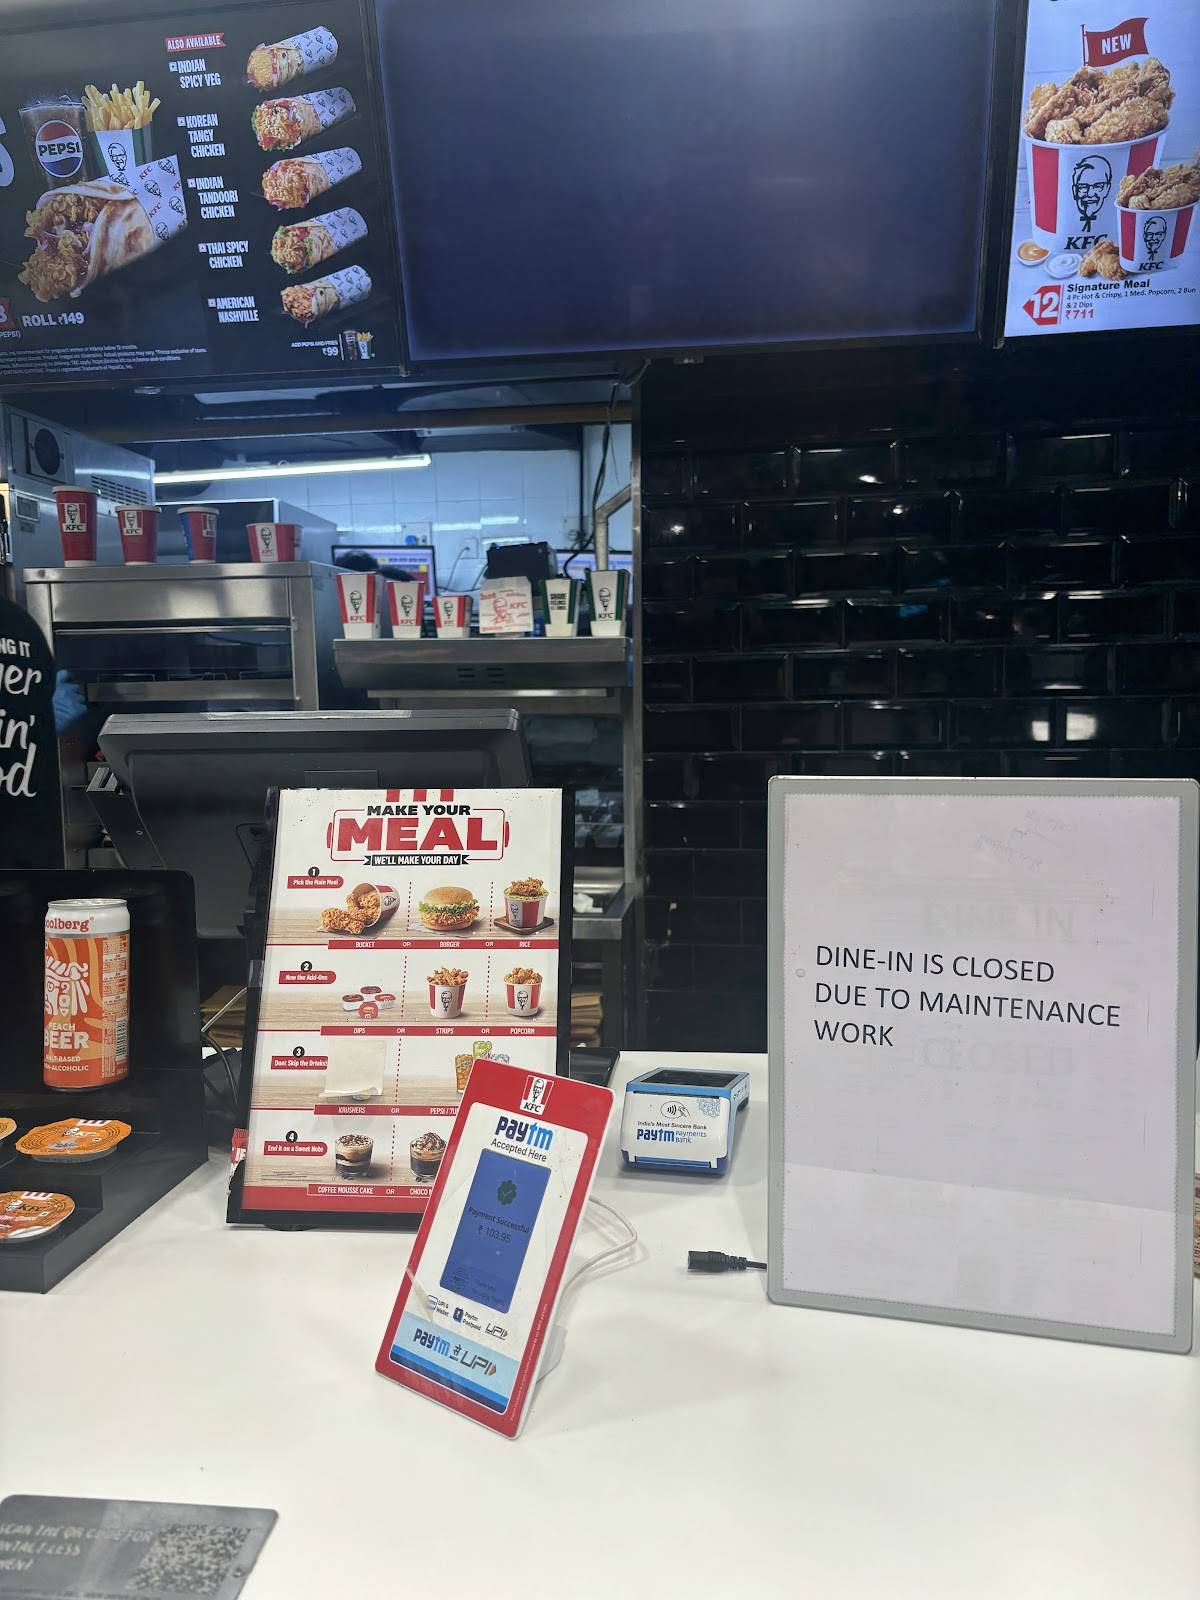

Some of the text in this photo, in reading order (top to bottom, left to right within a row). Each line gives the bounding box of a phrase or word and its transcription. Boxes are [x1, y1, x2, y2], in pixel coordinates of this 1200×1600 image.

[167, 35, 221, 50] ALSO AVAILABLE
[1102, 33, 1131, 55] NEW
[177, 58, 206, 73] INDIAN
[180, 73, 221, 88] SPICY VEG
[185, 113, 218, 128] KOREAN
[188, 129, 214, 143] TANGY
[191, 143, 225, 158] CHICKEN
[139, 166, 153, 180] KFC
[195, 176, 224, 190] INDIAN
[198, 190, 239, 204] TANDOORI
[149, 203, 162, 218] KFC
[201, 205, 235, 219] CHICKEN
[206, 241, 249, 255] THAI SPICY
[209, 255, 243, 269] CHICKEN
[1138, 261, 1164, 272] KFC
[1067, 279, 1150, 293] Signature Meal
[1101, 291, 1123, 301] Crispy,
[1129, 289, 1146, 297] Med.
[1148, 288, 1176, 297] Popcorn,
[216, 296, 255, 310] AMERICAN
[1031, 291, 1059, 319] 12
[1078, 301, 1093, 309] Dips
[22, 314, 57, 328] ROLL
[58, 312, 85, 325] ₹149
[218, 309, 259, 323] NASHVILLE
[1065, 308, 1095, 320] ₹711
[322, 347, 339, 356] ₹99
[65, 524, 84, 532] KFC
[19, 640, 30, 658] IT
[367, 805, 471, 816] MAKE YOUR
[337, 817, 497, 851] MEAL
[374, 855, 459, 865] WE'LL MAKE YOUR DAY
[816, 945, 1055, 982] DINE-IN IS CLOSED
[815, 982, 1121, 1027] DUE TO MAINTENANCE
[48, 1022, 76, 1031] PEACH
[813, 1019, 894, 1047] WORK
[44, 1029, 89, 1049] BEER
[338, 1106, 366, 1114] KRUSHERS
[430, 1107, 445, 1115] PEPSI
[524, 1102, 541, 1113] KFC
[289, 1132, 295, 1141] 4
[491, 1138, 547, 1161] Accepted Here
[337, 1186, 358, 1194] MOUSSE
[359, 1187, 374, 1195] CAKE
[468, 1206, 529, 1234] Payment Successful
[485, 1227, 512, 1243] 103.95
[436, 1307, 449, 1317] Wallet
[464, 1311, 478, 1321] Paytm
[463, 1318, 482, 1331] Postpaid
[485, 1323, 505, 1338] UPI
[460, 1350, 493, 1375] UPI
